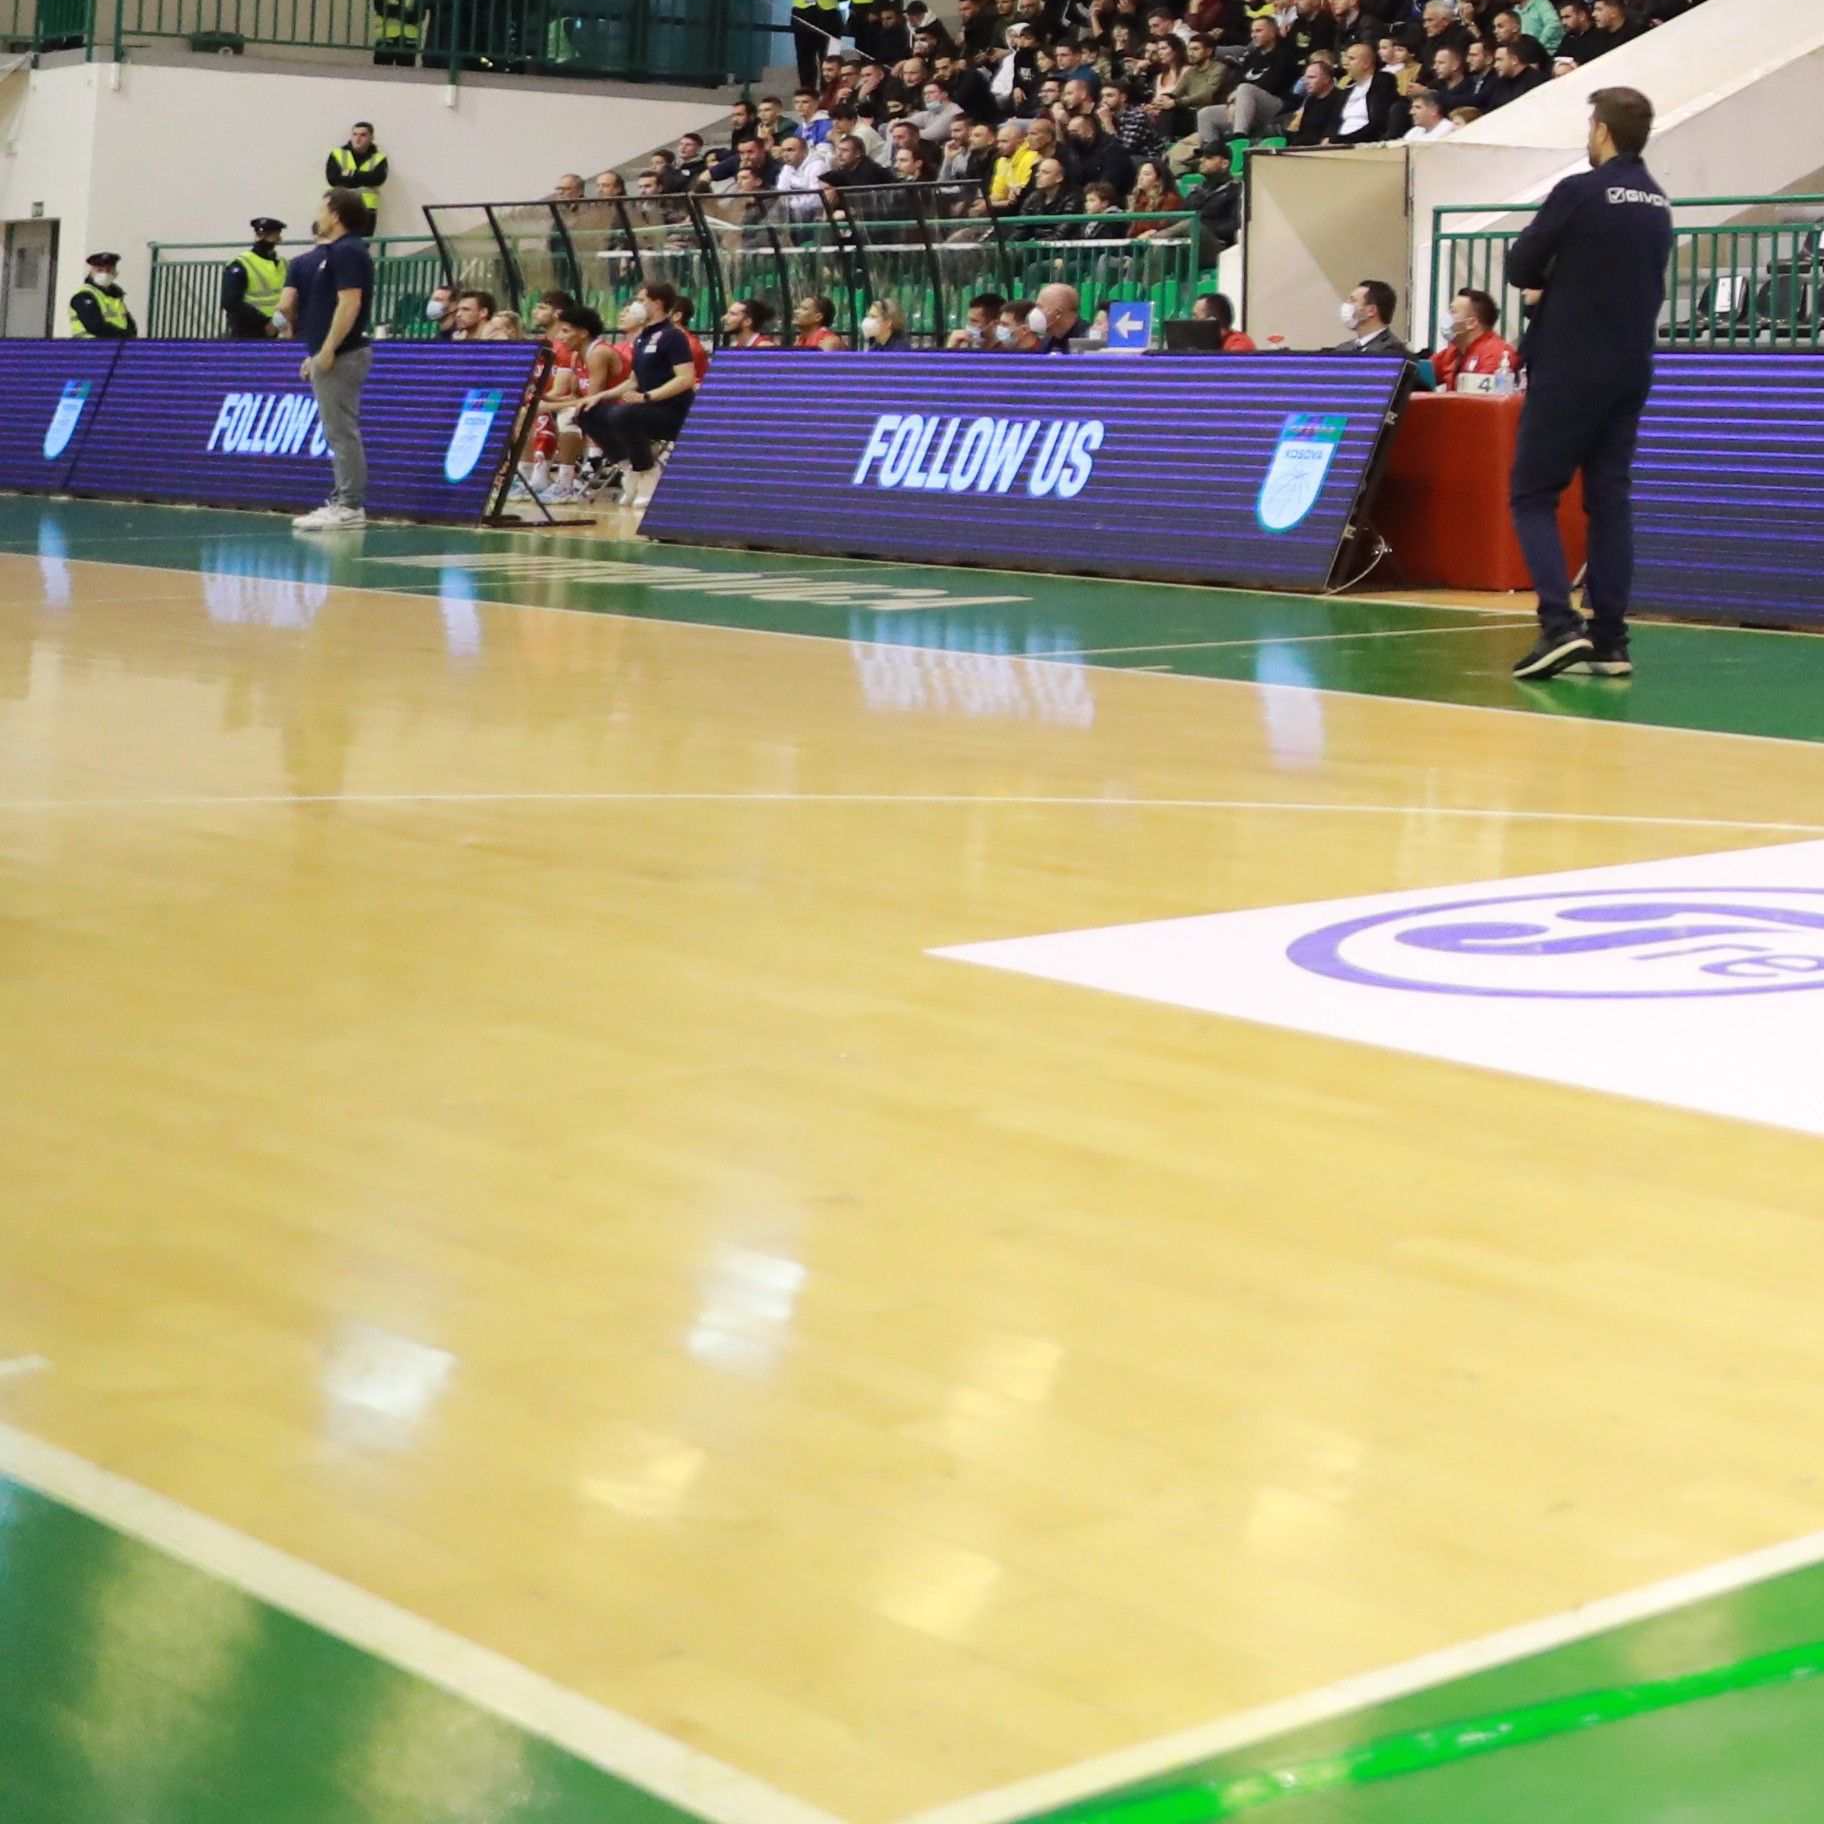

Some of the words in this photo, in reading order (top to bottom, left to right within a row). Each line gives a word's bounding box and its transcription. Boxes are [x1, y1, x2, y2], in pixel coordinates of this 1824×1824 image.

[1478, 377, 1493, 393] 4
[853, 414, 1040, 497] FOLLOW
[1029, 419, 1106, 499] US
